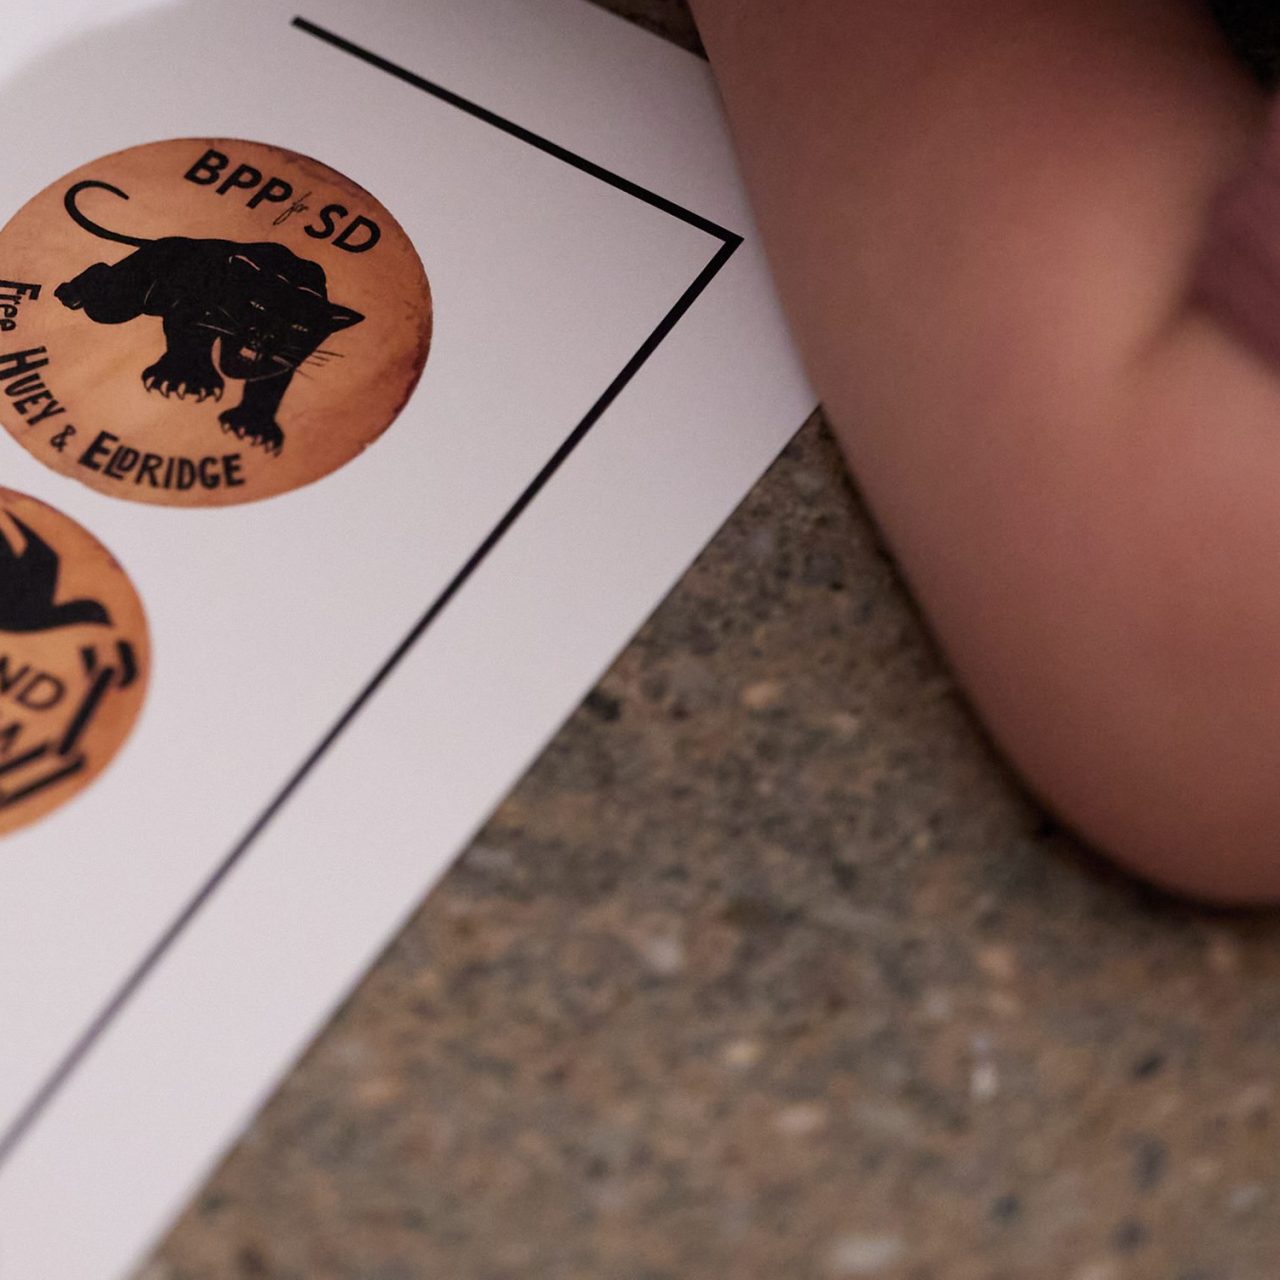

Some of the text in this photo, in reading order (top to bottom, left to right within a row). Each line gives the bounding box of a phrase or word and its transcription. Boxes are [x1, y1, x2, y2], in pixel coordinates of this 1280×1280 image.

[184, 149, 293, 210] BPP
[305, 203, 382, 254] SD
[50, 424, 77, 453] &
[79, 431, 246, 491] ELDRIDGE
